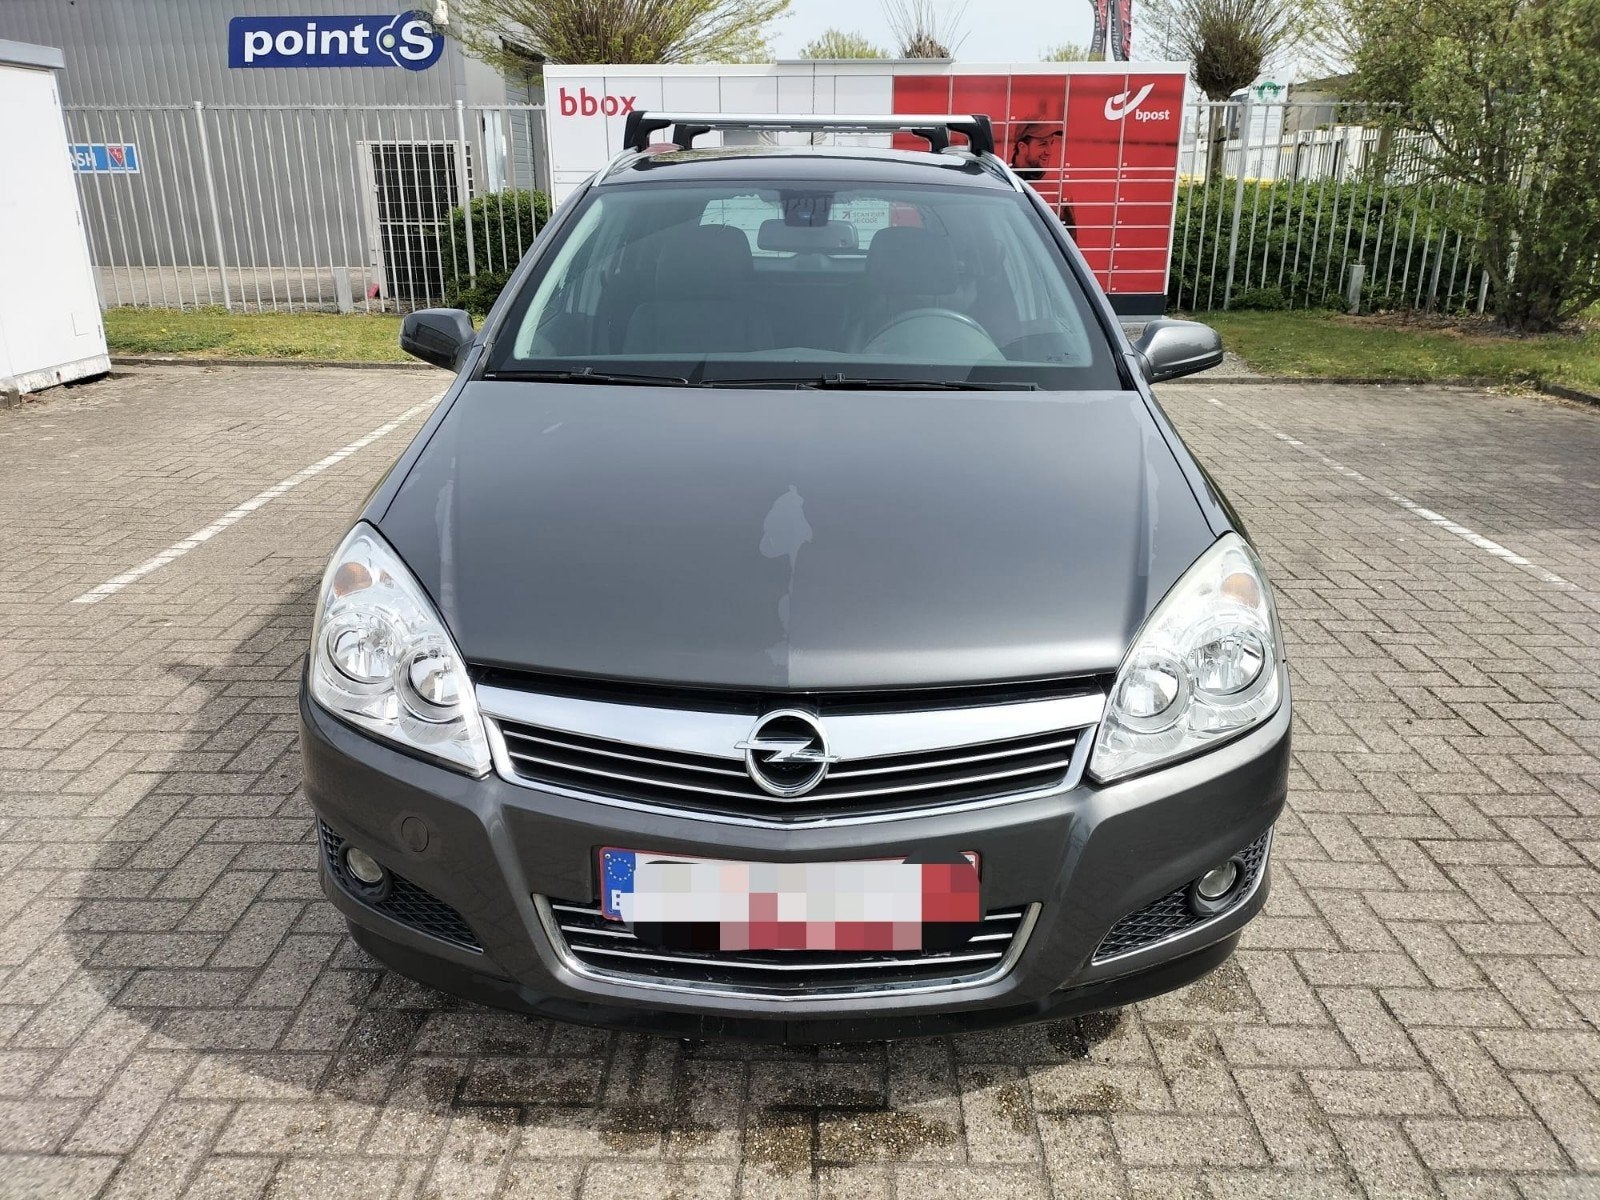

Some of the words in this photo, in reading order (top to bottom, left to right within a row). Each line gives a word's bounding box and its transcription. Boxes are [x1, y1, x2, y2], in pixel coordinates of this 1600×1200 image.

[244, 22, 370, 62] point
[399, 20, 434, 61] S
[559, 87, 637, 116] bbox
[1135, 108, 1170, 123] bpost
